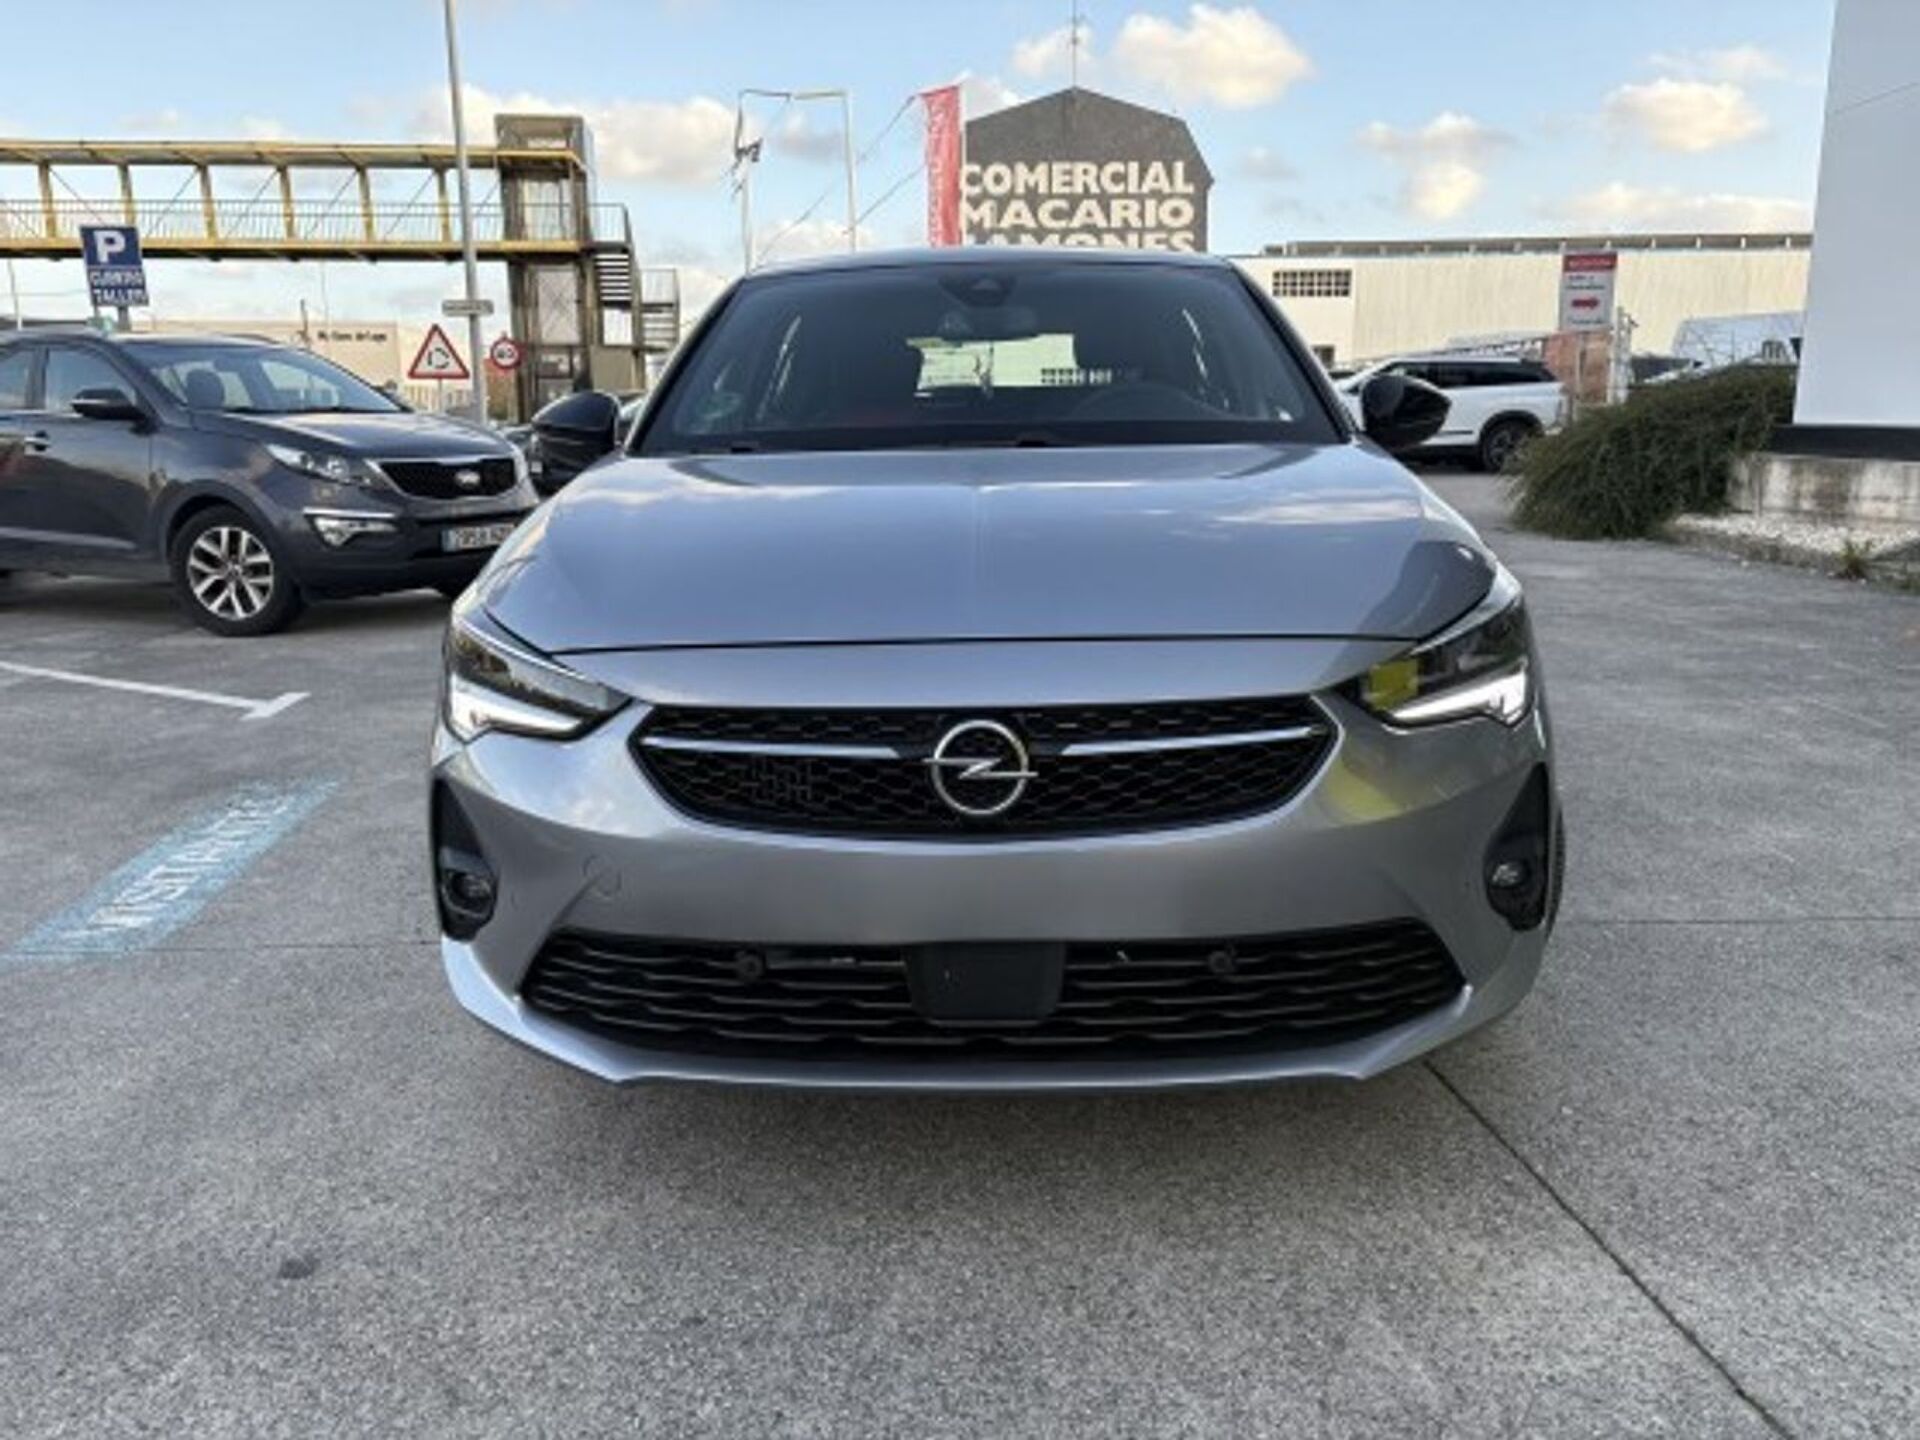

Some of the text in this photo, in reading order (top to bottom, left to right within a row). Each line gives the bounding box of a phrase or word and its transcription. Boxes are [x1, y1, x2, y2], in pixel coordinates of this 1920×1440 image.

[961, 161, 1194, 195] COMERCIAL
[962, 200, 1195, 229] MACARIO
[94, 231, 127, 262] P
